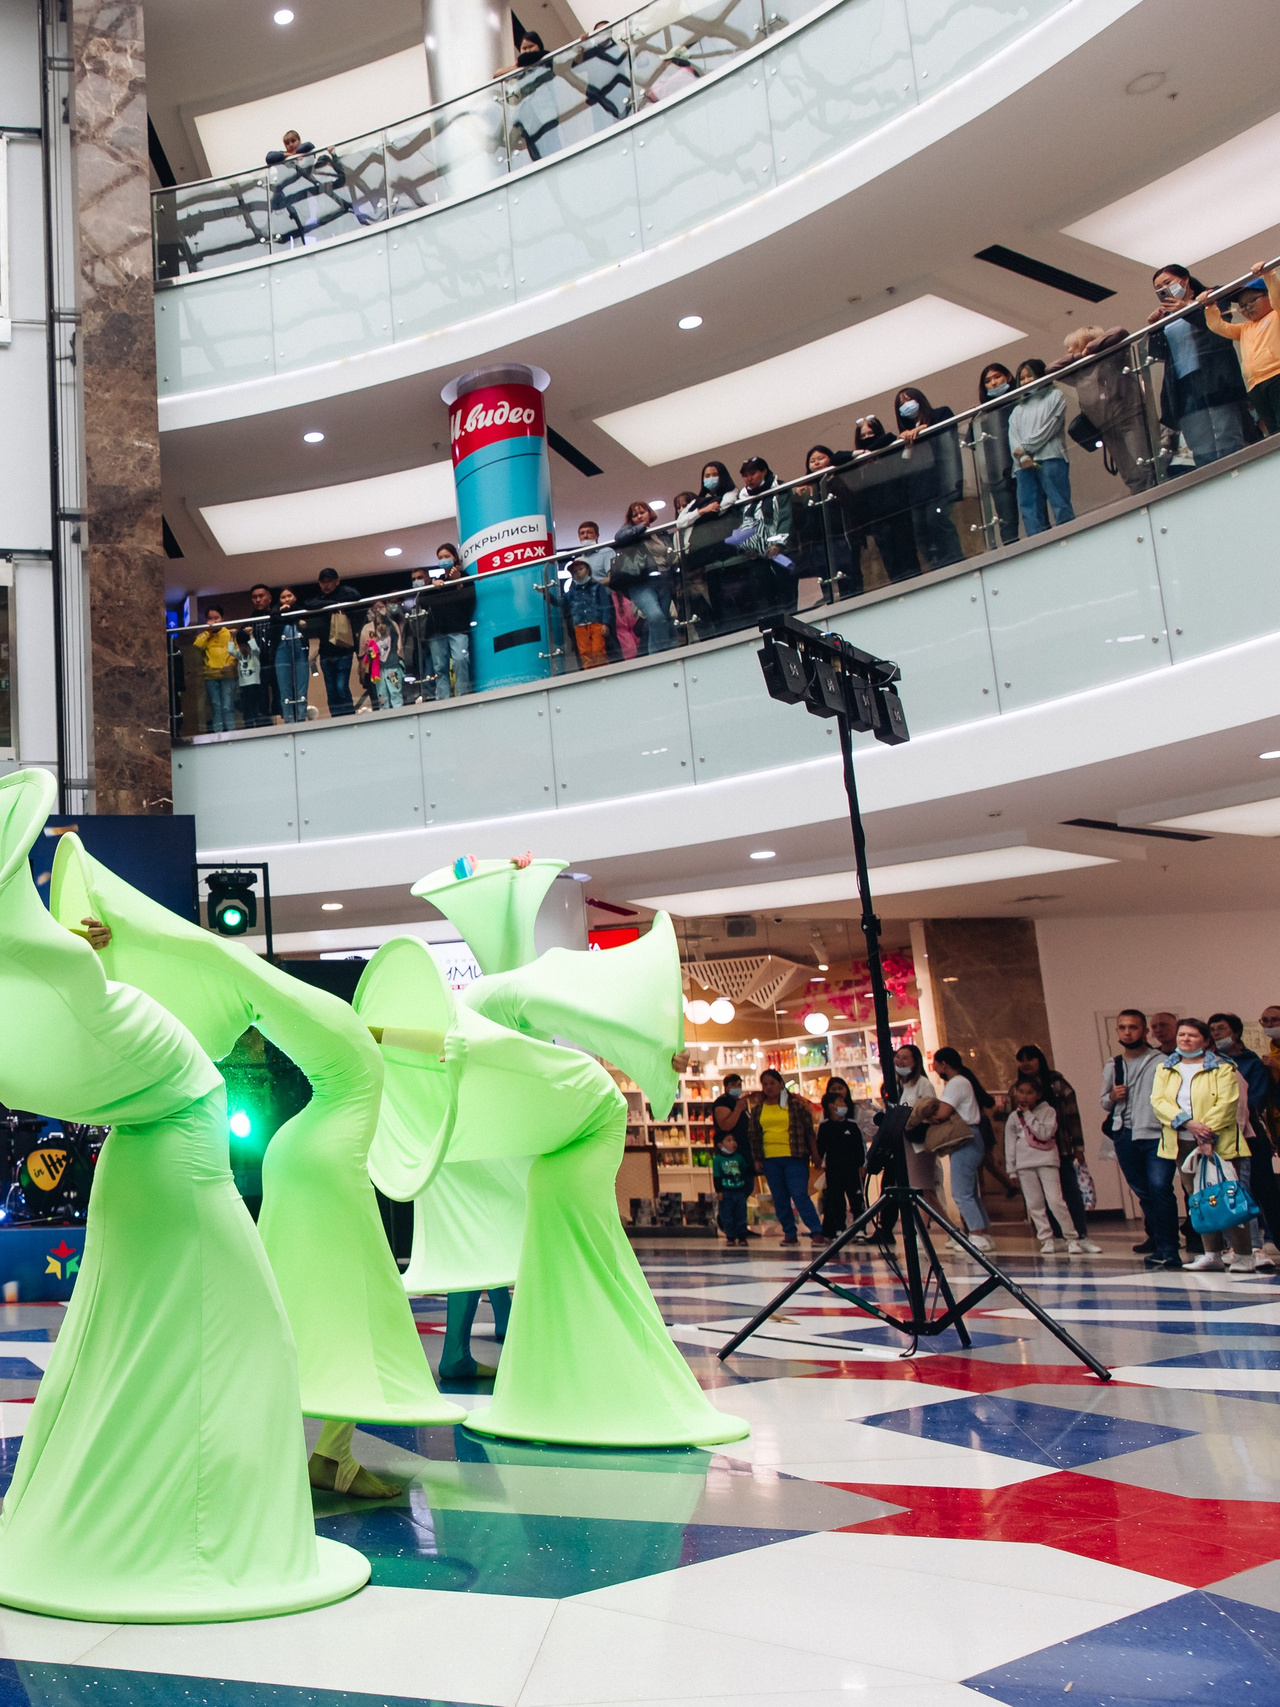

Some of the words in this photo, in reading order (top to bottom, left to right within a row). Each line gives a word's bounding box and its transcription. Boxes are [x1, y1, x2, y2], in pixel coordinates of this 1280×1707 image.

[463, 523, 539, 559] ОТКРЫЛИСЬ!
[491, 555, 501, 568] 3
[504, 546, 546, 563] ЭТАЖ
